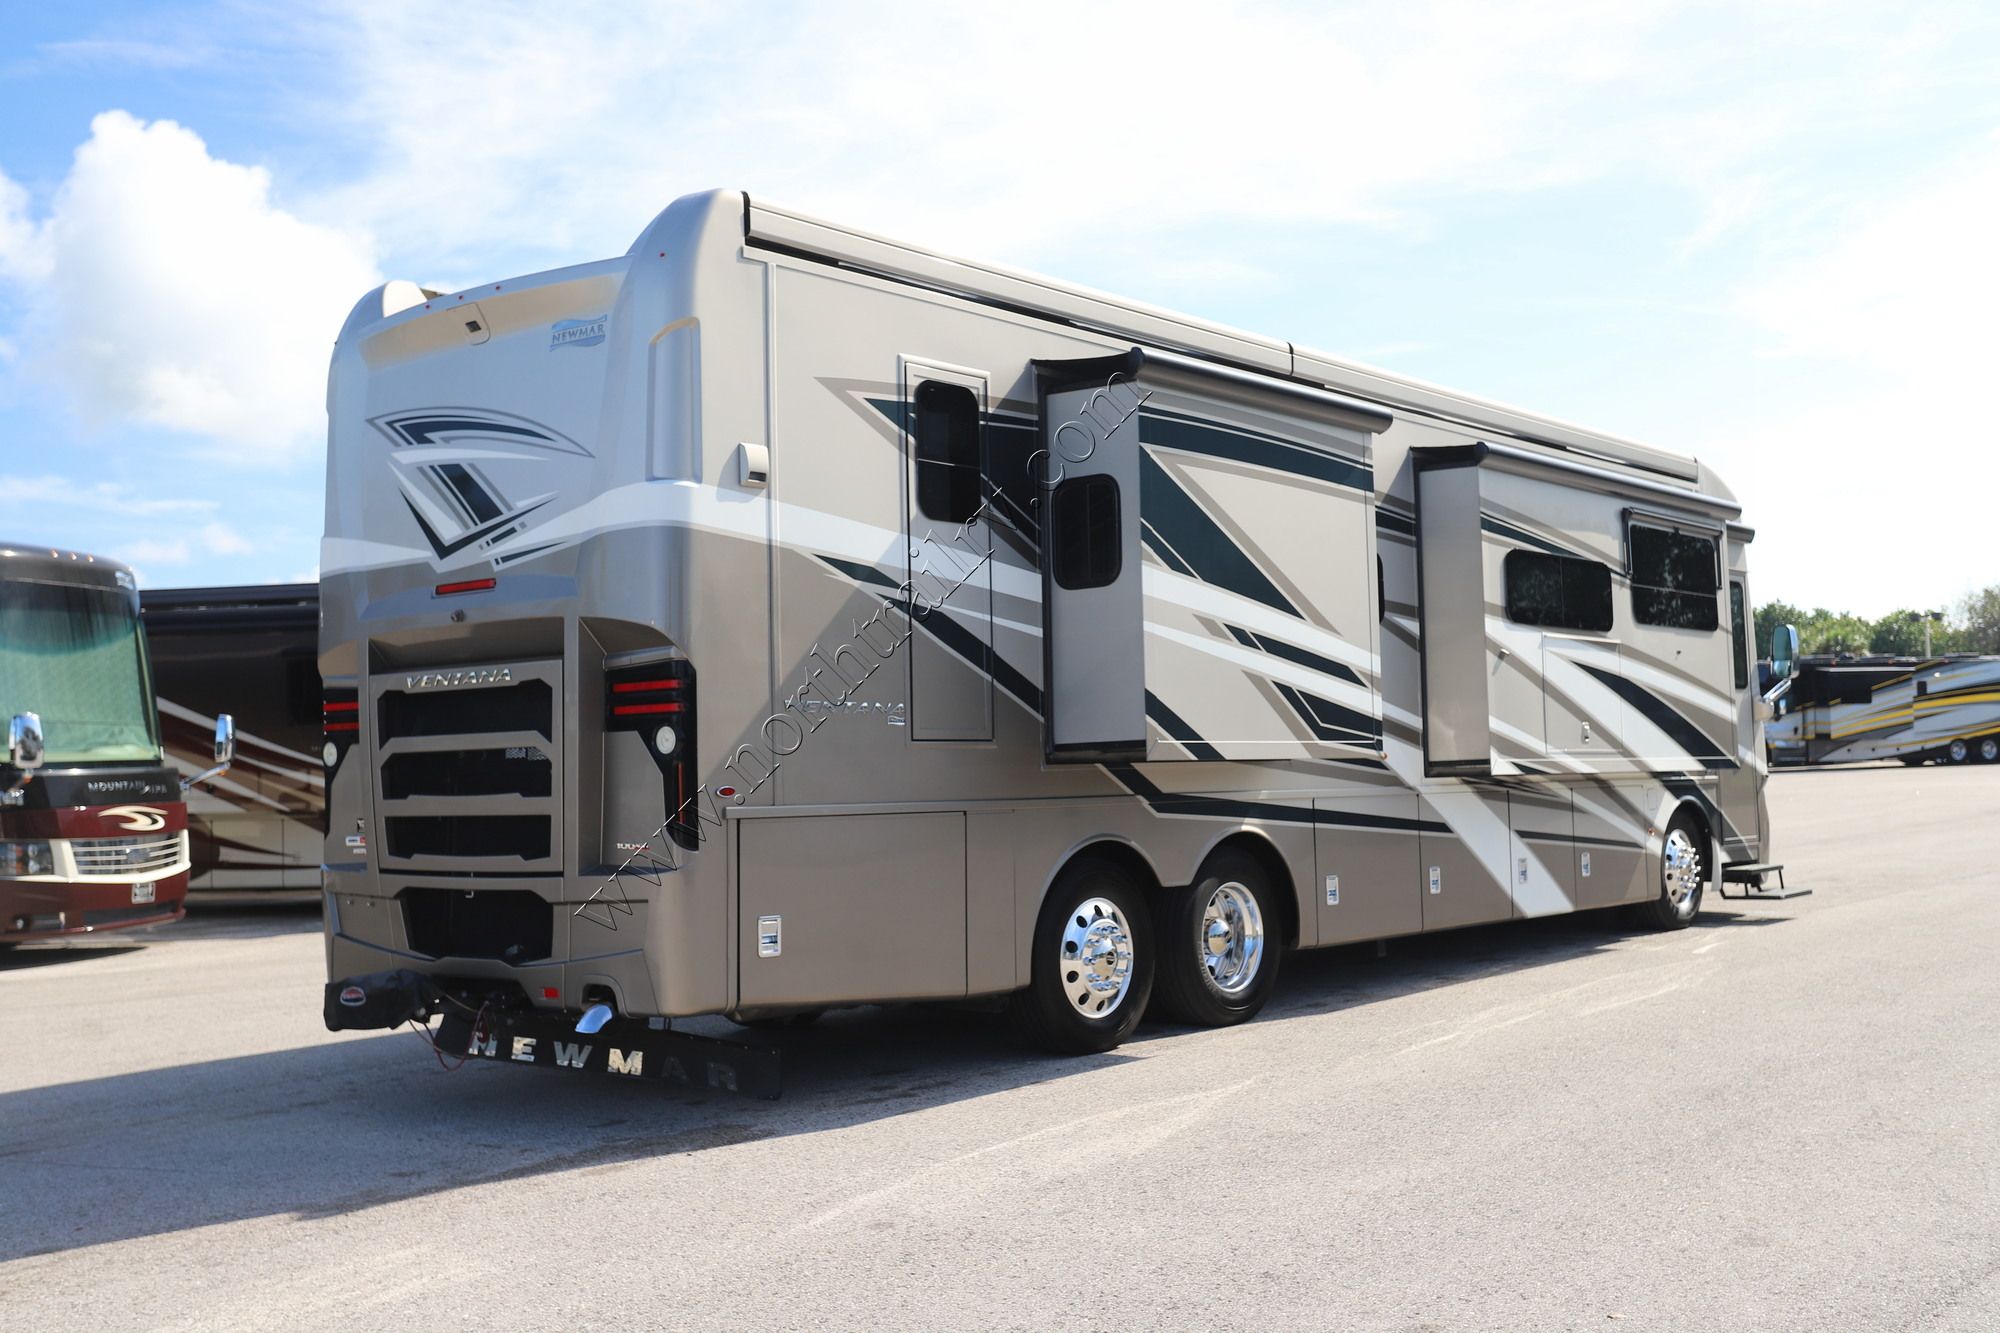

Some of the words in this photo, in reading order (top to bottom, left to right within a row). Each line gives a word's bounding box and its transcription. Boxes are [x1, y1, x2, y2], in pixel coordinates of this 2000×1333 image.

[551, 323, 605, 344] NEWMAR
[406, 667, 512, 689] VENTANA
[467, 1030, 739, 1092] NEWMAR
